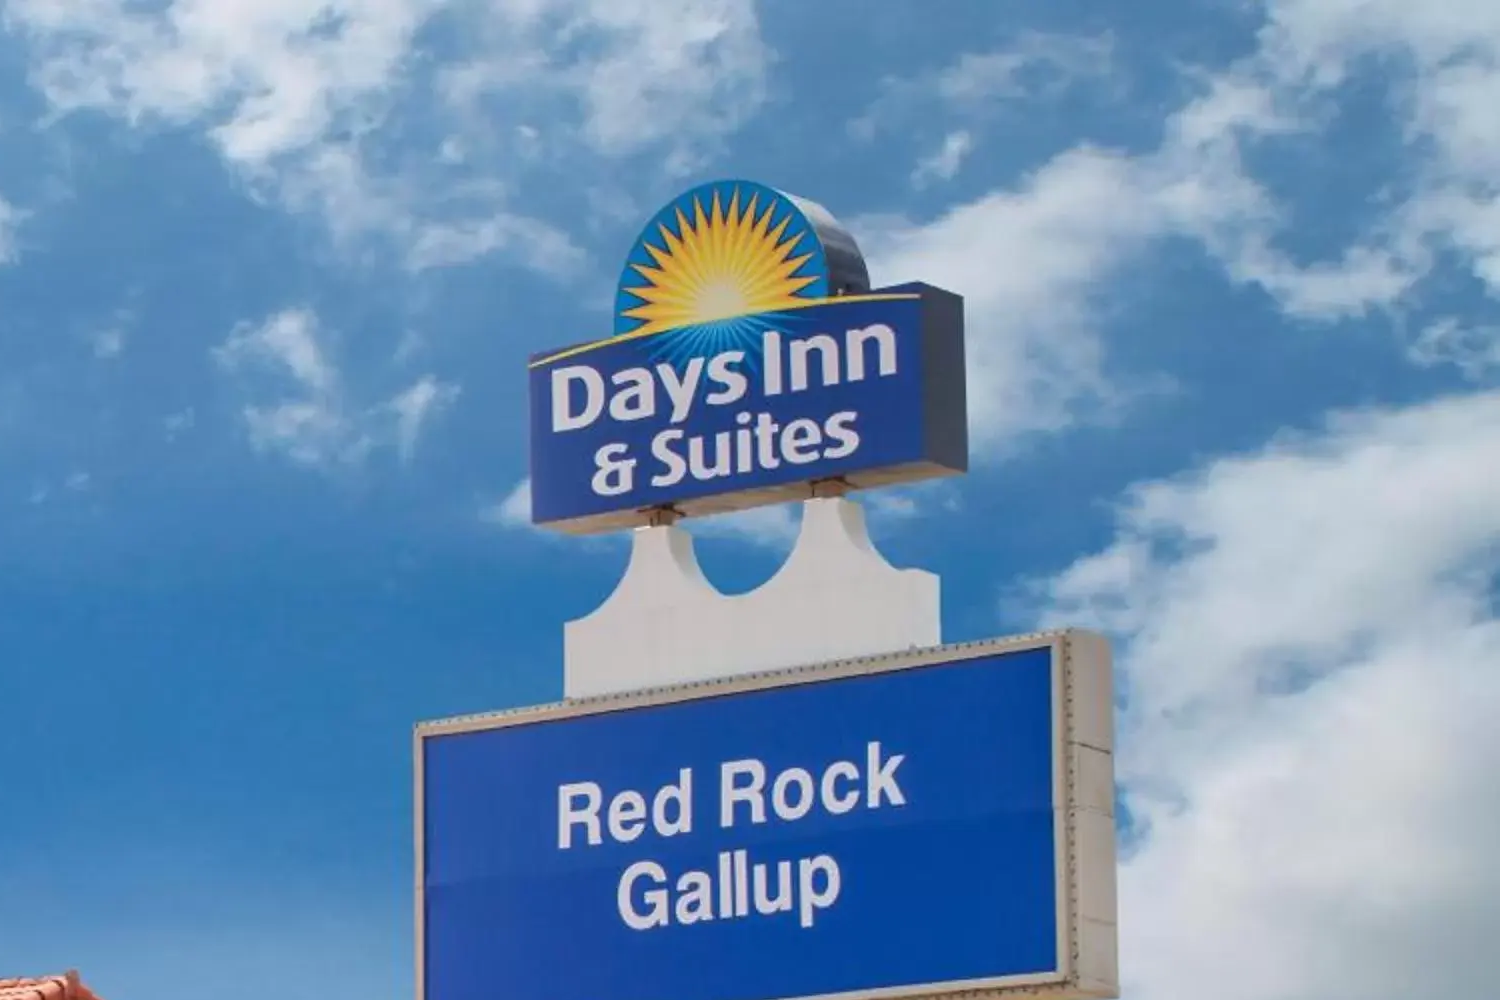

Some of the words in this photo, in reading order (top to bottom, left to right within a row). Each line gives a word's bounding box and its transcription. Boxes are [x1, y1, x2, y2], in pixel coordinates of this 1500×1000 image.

[552, 351, 748, 433] Days
[763, 323, 897, 396] Inn
[591, 443, 637, 496] &
[651, 411, 860, 487] Suites
[558, 768, 692, 849] Red
[720, 741, 907, 828] Rock
[617, 849, 841, 931] Gallup
